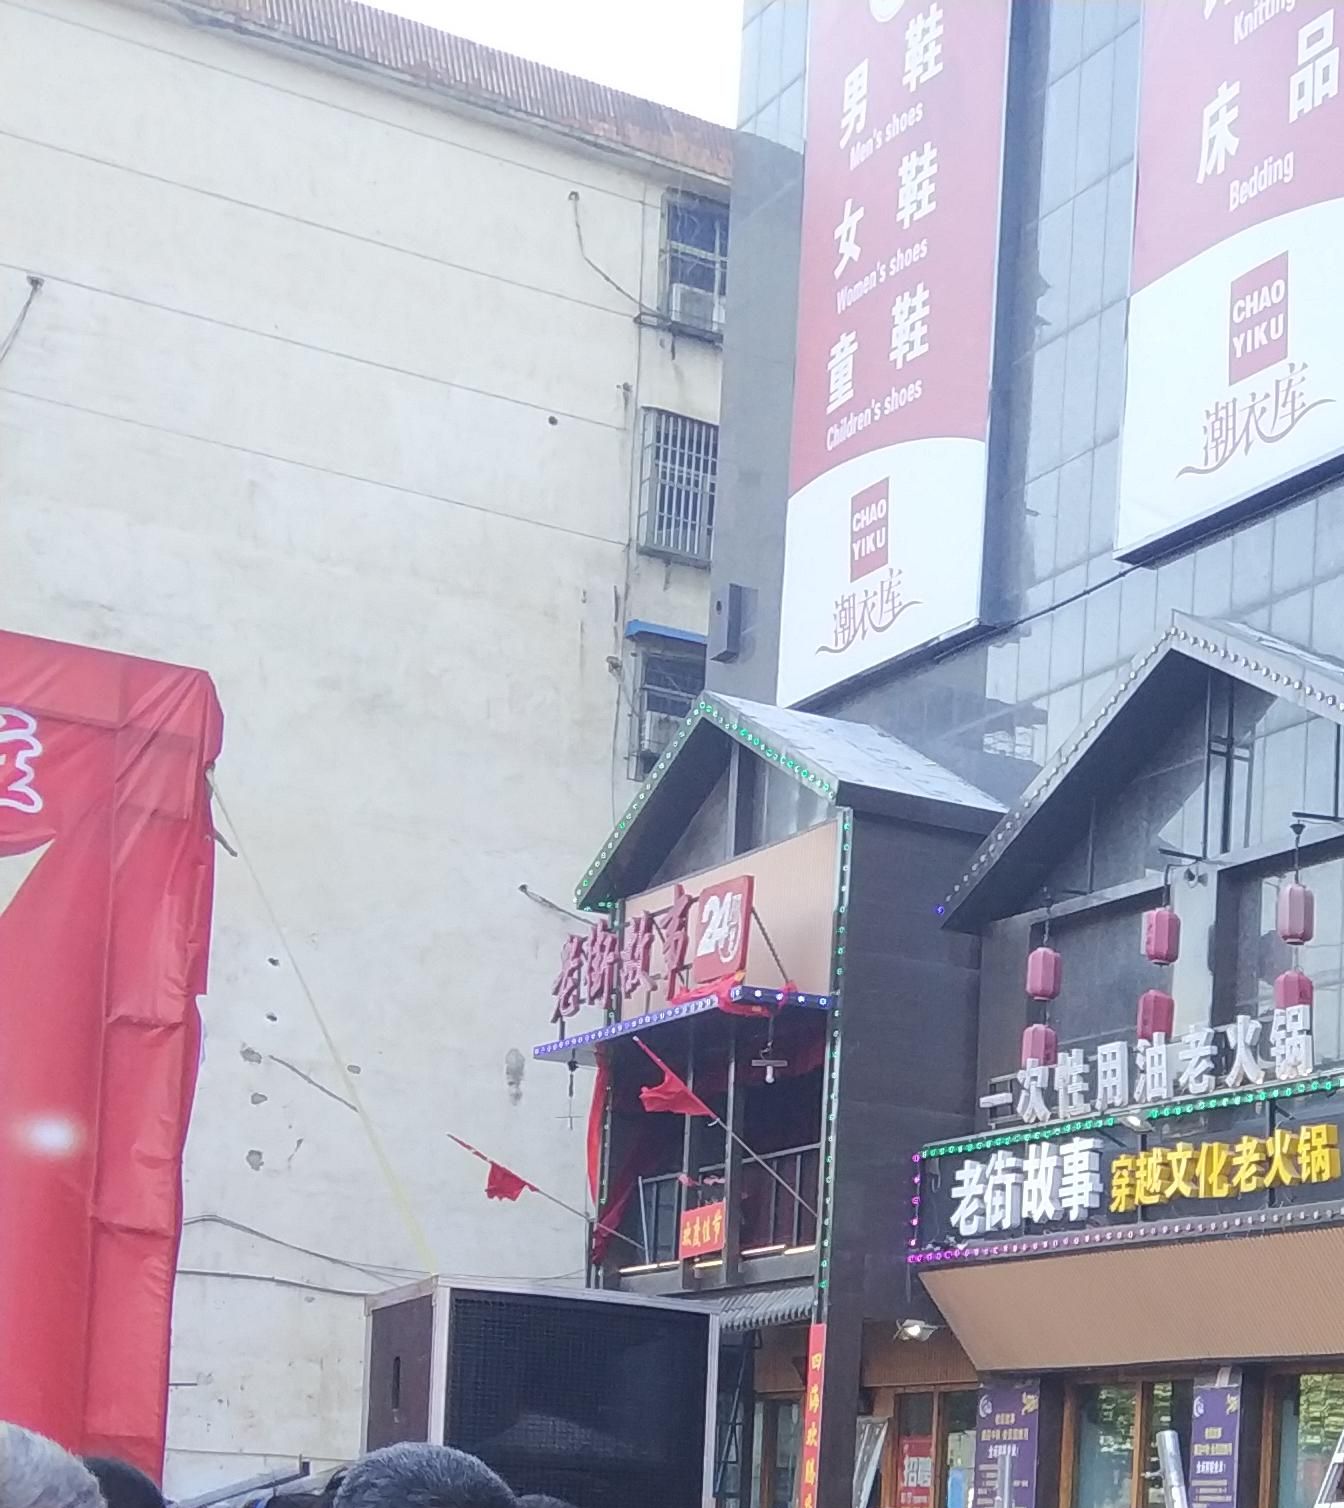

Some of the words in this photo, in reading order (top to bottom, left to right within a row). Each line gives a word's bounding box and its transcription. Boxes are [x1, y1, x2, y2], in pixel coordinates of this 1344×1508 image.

[850, 128, 883, 171] Men's
[885, 102, 923, 142] shoes
[1196, 9, 1339, 184] 床品
[833, 142, 938, 280] 女鞋
[1229, 152, 1294, 212] Bedding
[836, 260, 888, 315] Women's
[889, 238, 928, 281] shoes
[1231, 277, 1286, 325] CHAO
[826, 282, 930, 415] 童鞋
[1231, 316, 1285, 359] YIKU
[826, 397, 881, 452] Children's
[882, 378, 923, 420] shoes
[1202, 362, 1310, 469] 潮衣库
[851, 529, 887, 561] YIKU
[852, 496, 888, 533] CHAO
[831, 567, 906, 651] 潮衣库
[979, 1005, 1314, 1123] 一次性用油老火锅
[950, 1137, 1103, 1236] 老街故事
[1109, 1124, 1342, 1213] 穿越文化老火锅
